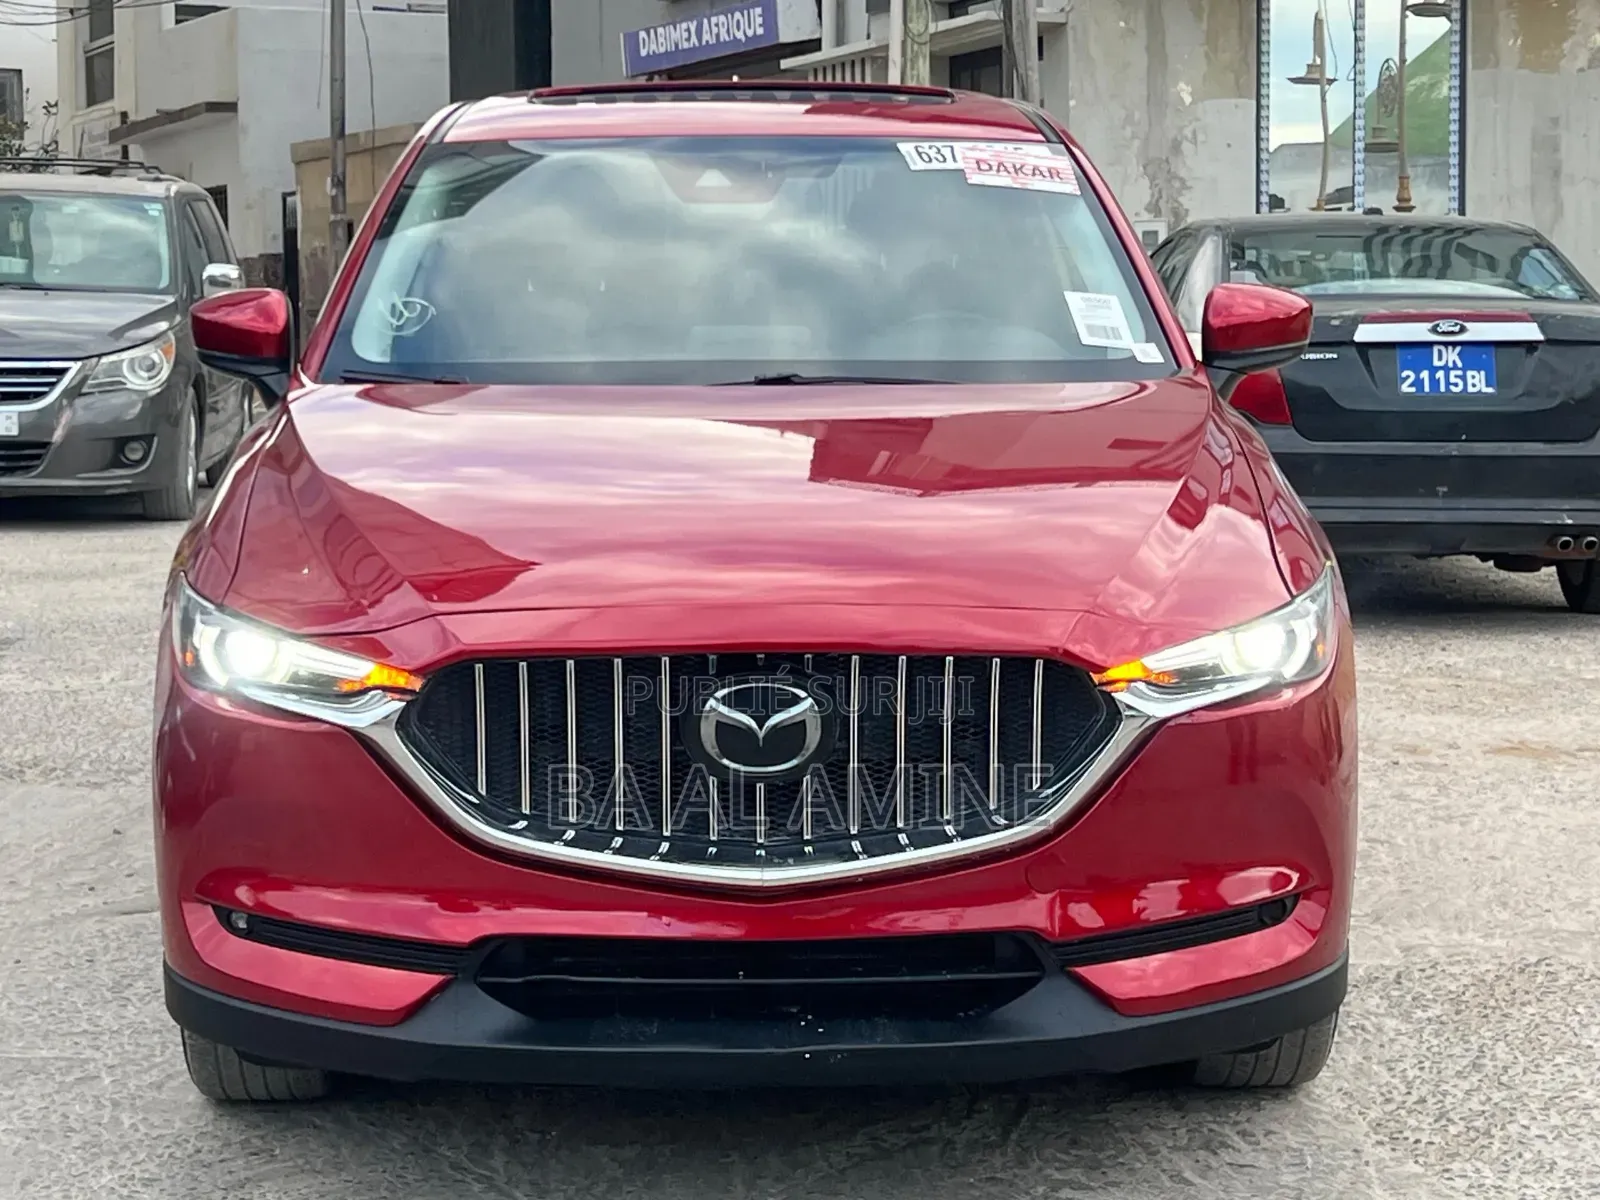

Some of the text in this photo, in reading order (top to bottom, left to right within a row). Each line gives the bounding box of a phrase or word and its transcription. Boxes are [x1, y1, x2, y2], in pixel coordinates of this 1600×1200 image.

[638, 7, 764, 57] DABIMEX AFRIQUE
[914, 145, 958, 164] 637
[975, 159, 1064, 181] DAKAR
[1436, 320, 1461, 333] Ford
[1432, 344, 1463, 368] DK
[1400, 370, 1496, 393] 2115BL
